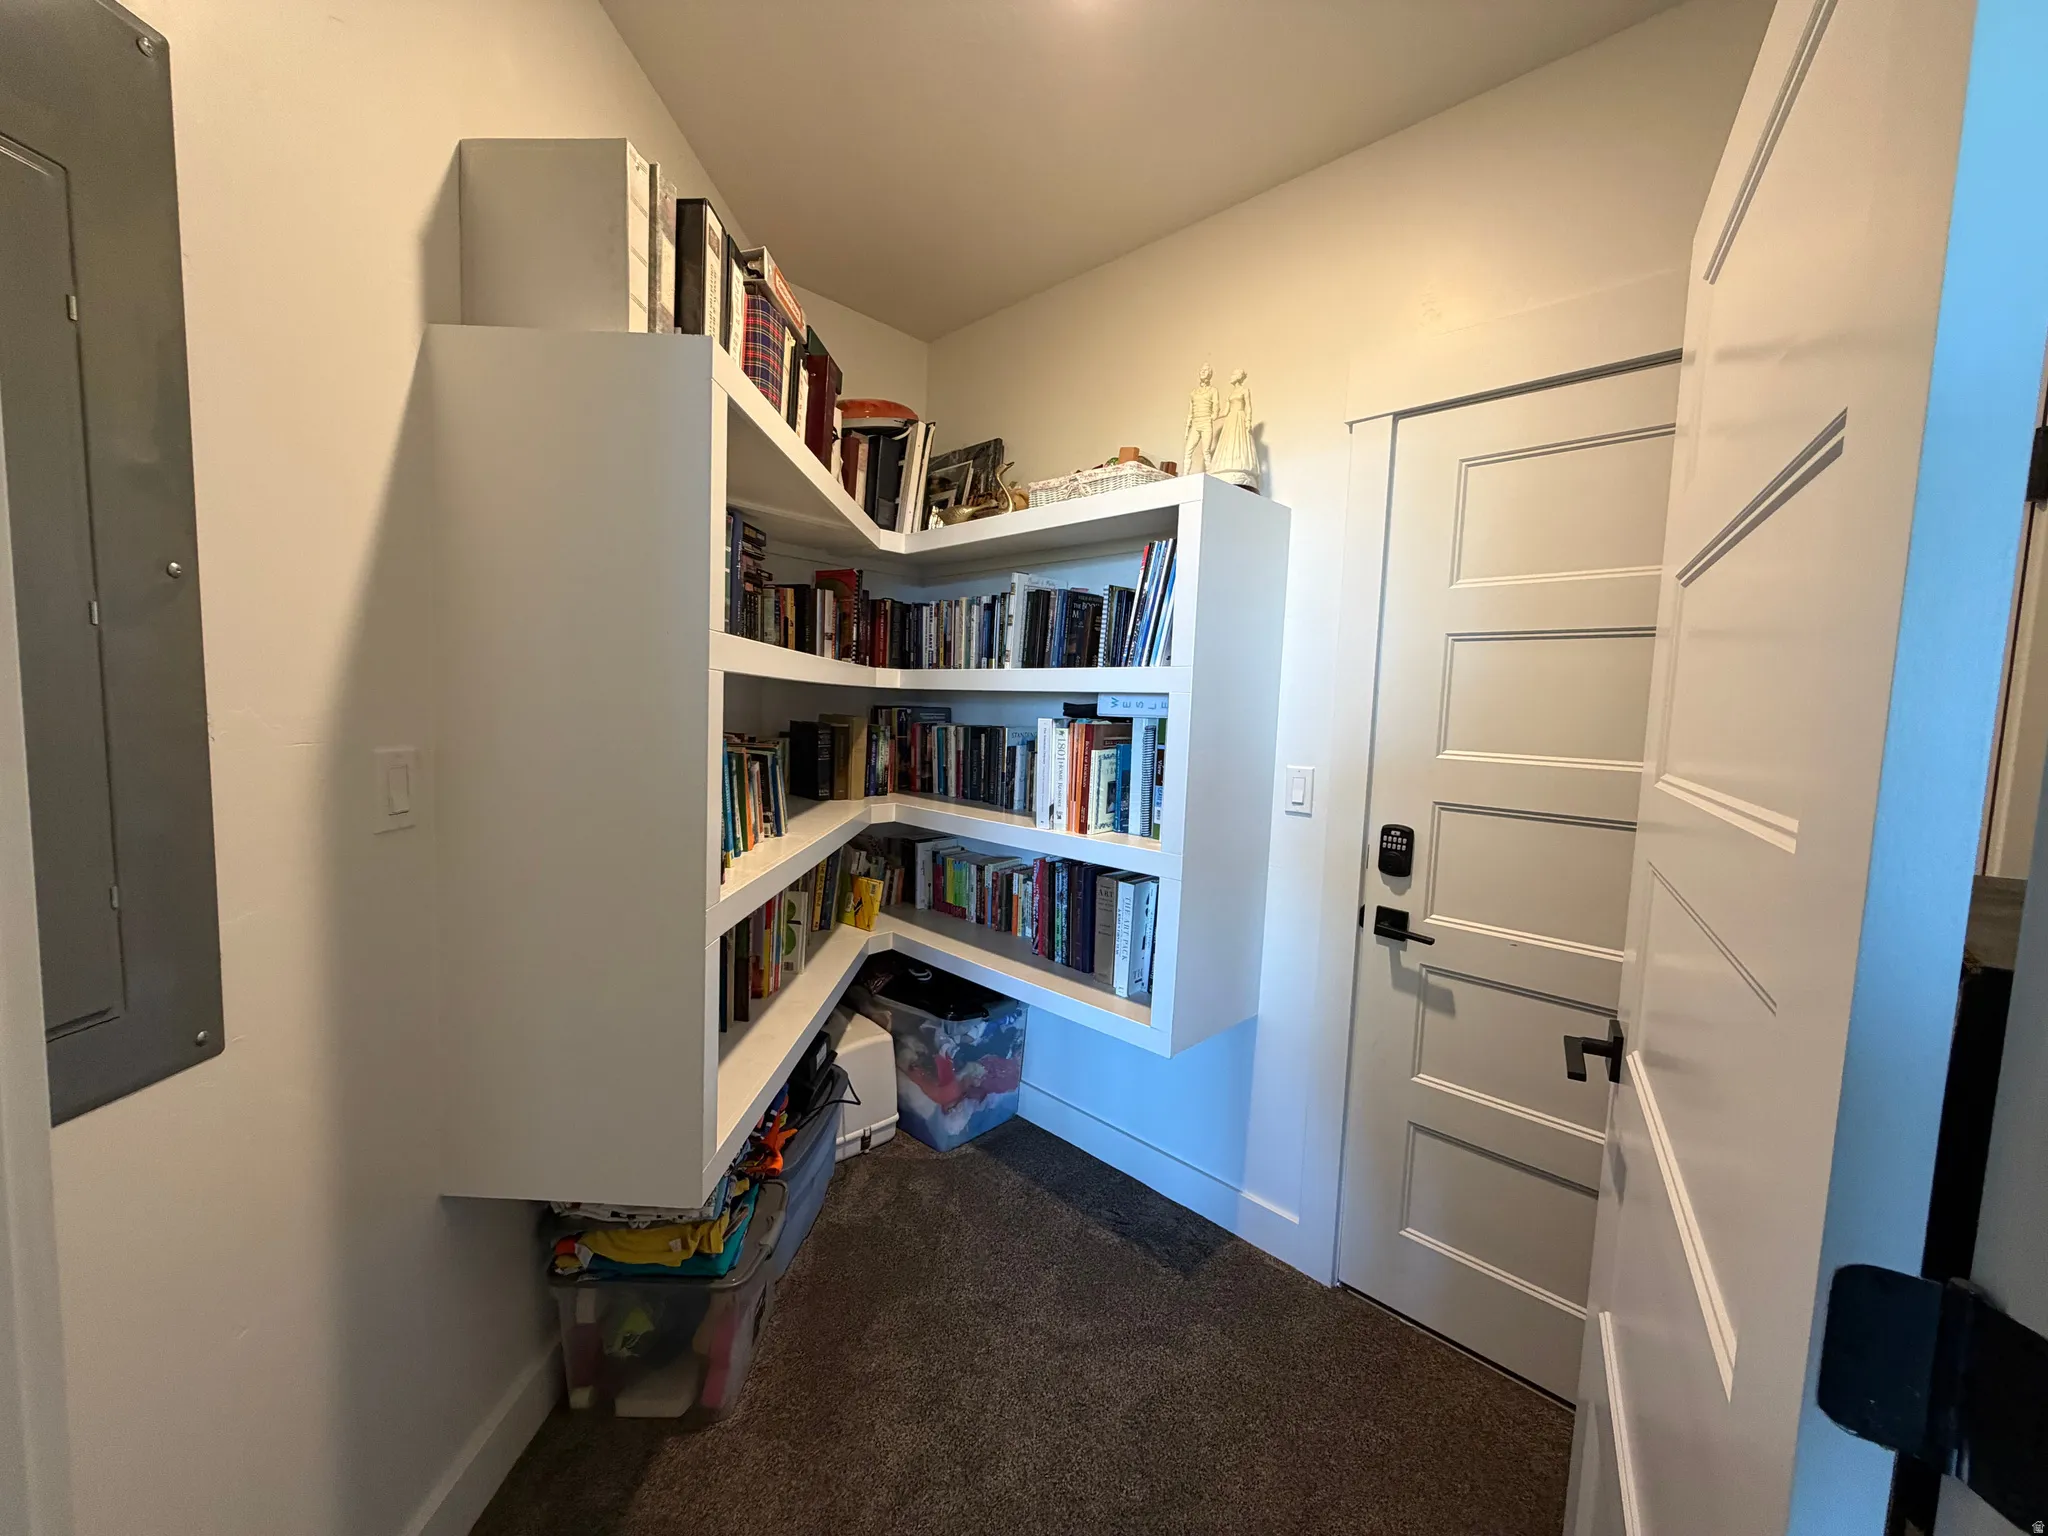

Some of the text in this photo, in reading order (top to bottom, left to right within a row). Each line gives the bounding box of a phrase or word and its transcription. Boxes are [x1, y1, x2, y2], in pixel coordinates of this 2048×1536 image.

[1057, 738, 1066, 761] 1801
[1057, 761, 1065, 781] HOME
[1124, 896, 1132, 915] THE
[1121, 939, 1129, 962] PACK
